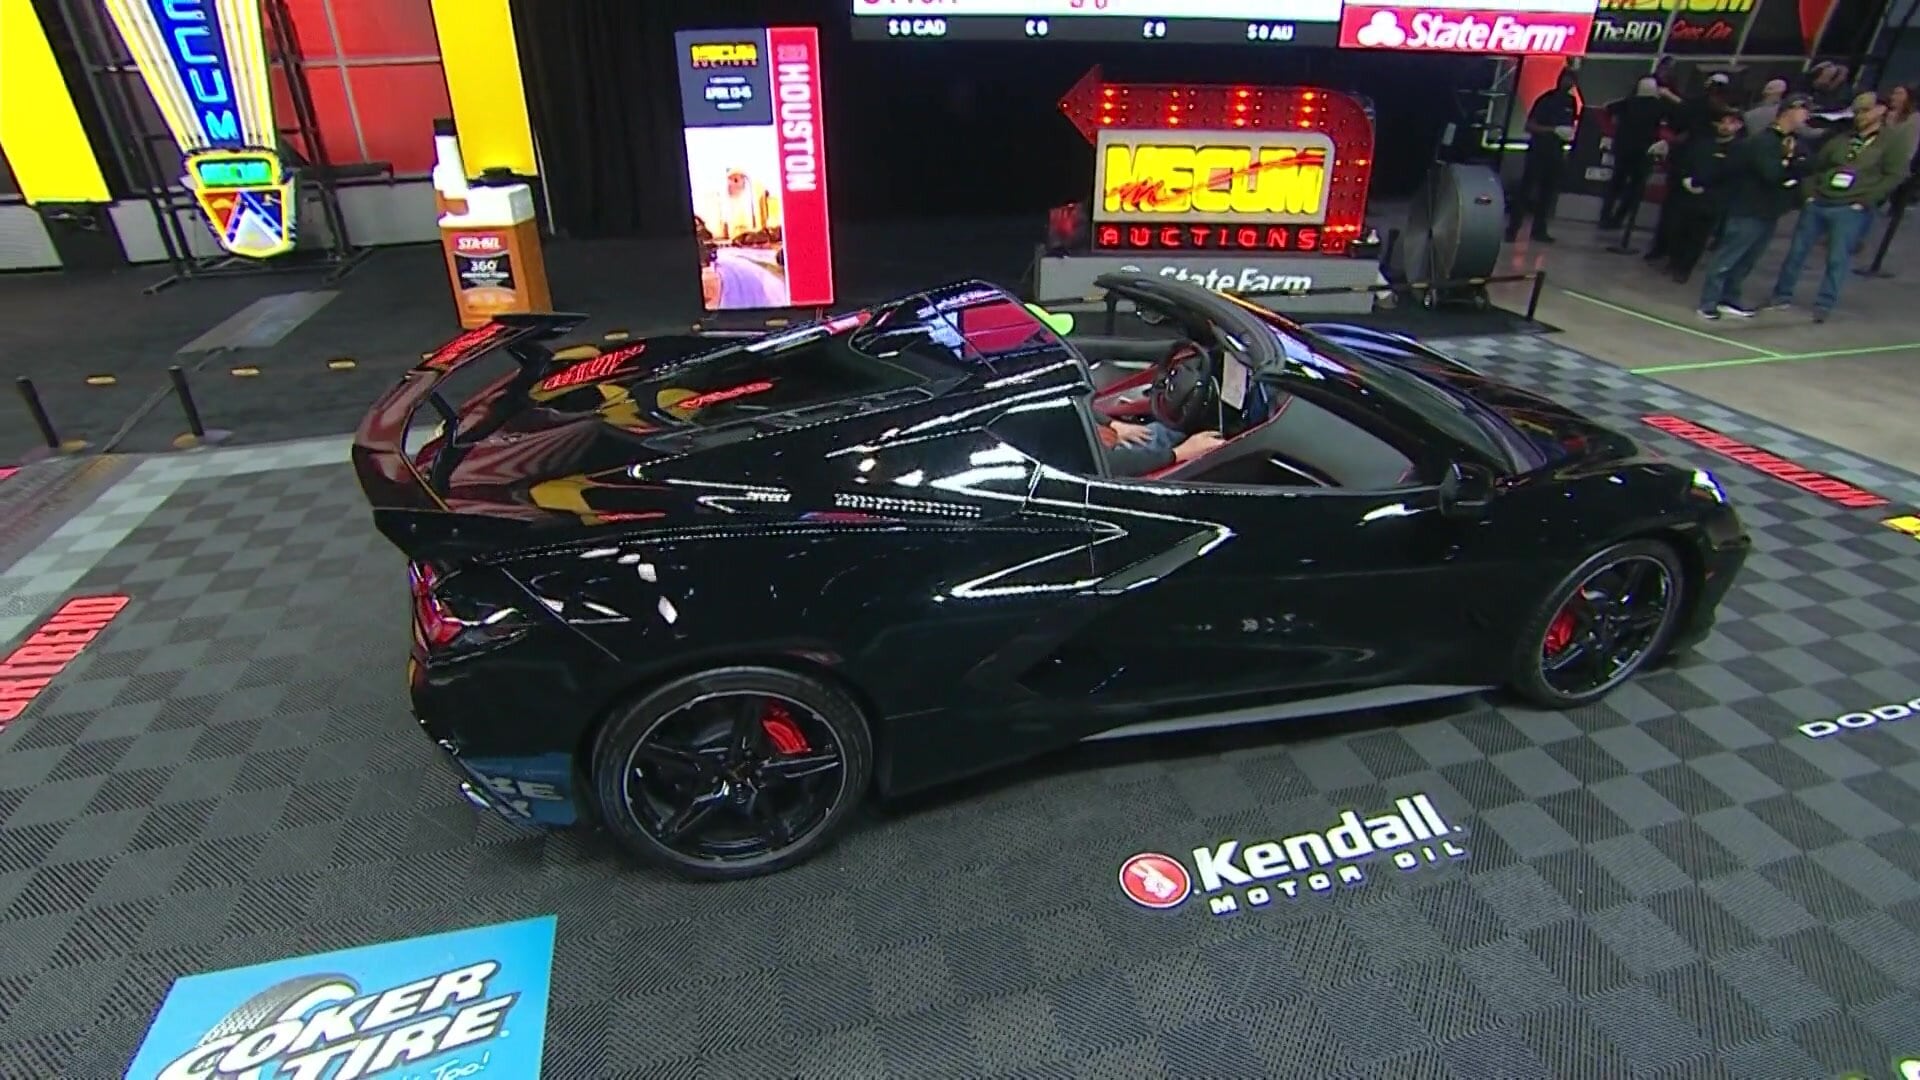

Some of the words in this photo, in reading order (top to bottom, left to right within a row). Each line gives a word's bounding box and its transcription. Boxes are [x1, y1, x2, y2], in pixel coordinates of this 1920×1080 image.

[778, 63, 817, 192] HOUSTON
[1104, 144, 1326, 213] MECUM
[1102, 228, 1317, 250] AUCTIONS
[1193, 793, 1449, 892] Kendall
[1209, 865, 1362, 915] MOTOR
[1395, 841, 1464, 870] OIL
